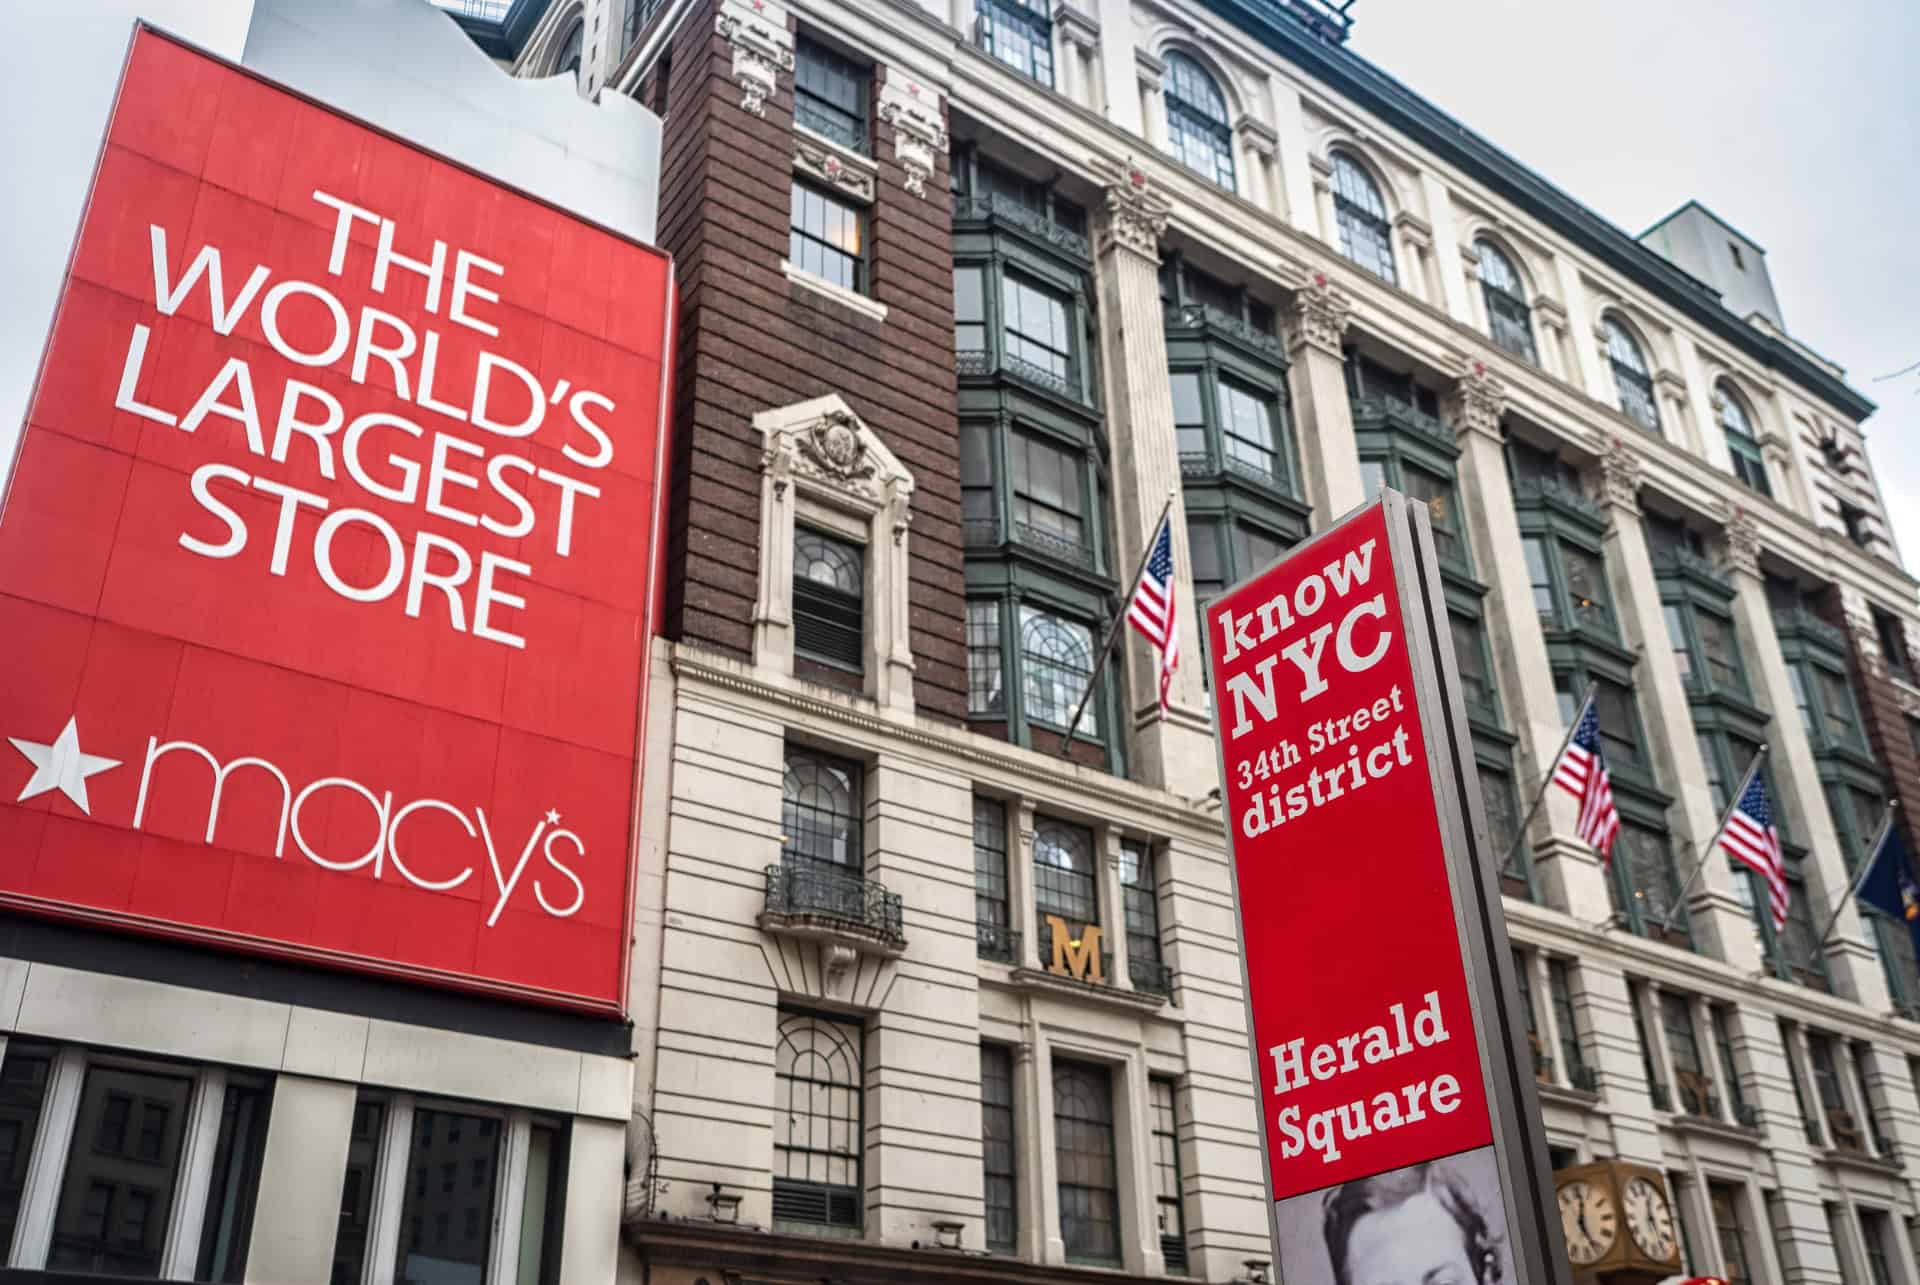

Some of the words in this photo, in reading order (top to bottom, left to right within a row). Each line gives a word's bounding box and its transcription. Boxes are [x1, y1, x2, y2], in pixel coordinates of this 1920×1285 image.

[313, 190, 504, 337] THE
[150, 224, 615, 468] WORLD'S
[115, 324, 600, 556] LARGEST
[179, 464, 532, 648] STORE
[1218, 538, 1377, 665] know
[1226, 593, 1393, 740] NYC
[1237, 740, 1302, 790] 34th
[1307, 684, 1404, 755] Street
[1242, 724, 1412, 838] district
[1046, 914, 1105, 985] M
[1269, 990, 1450, 1095] Herald
[1278, 1074, 1461, 1164] Square
